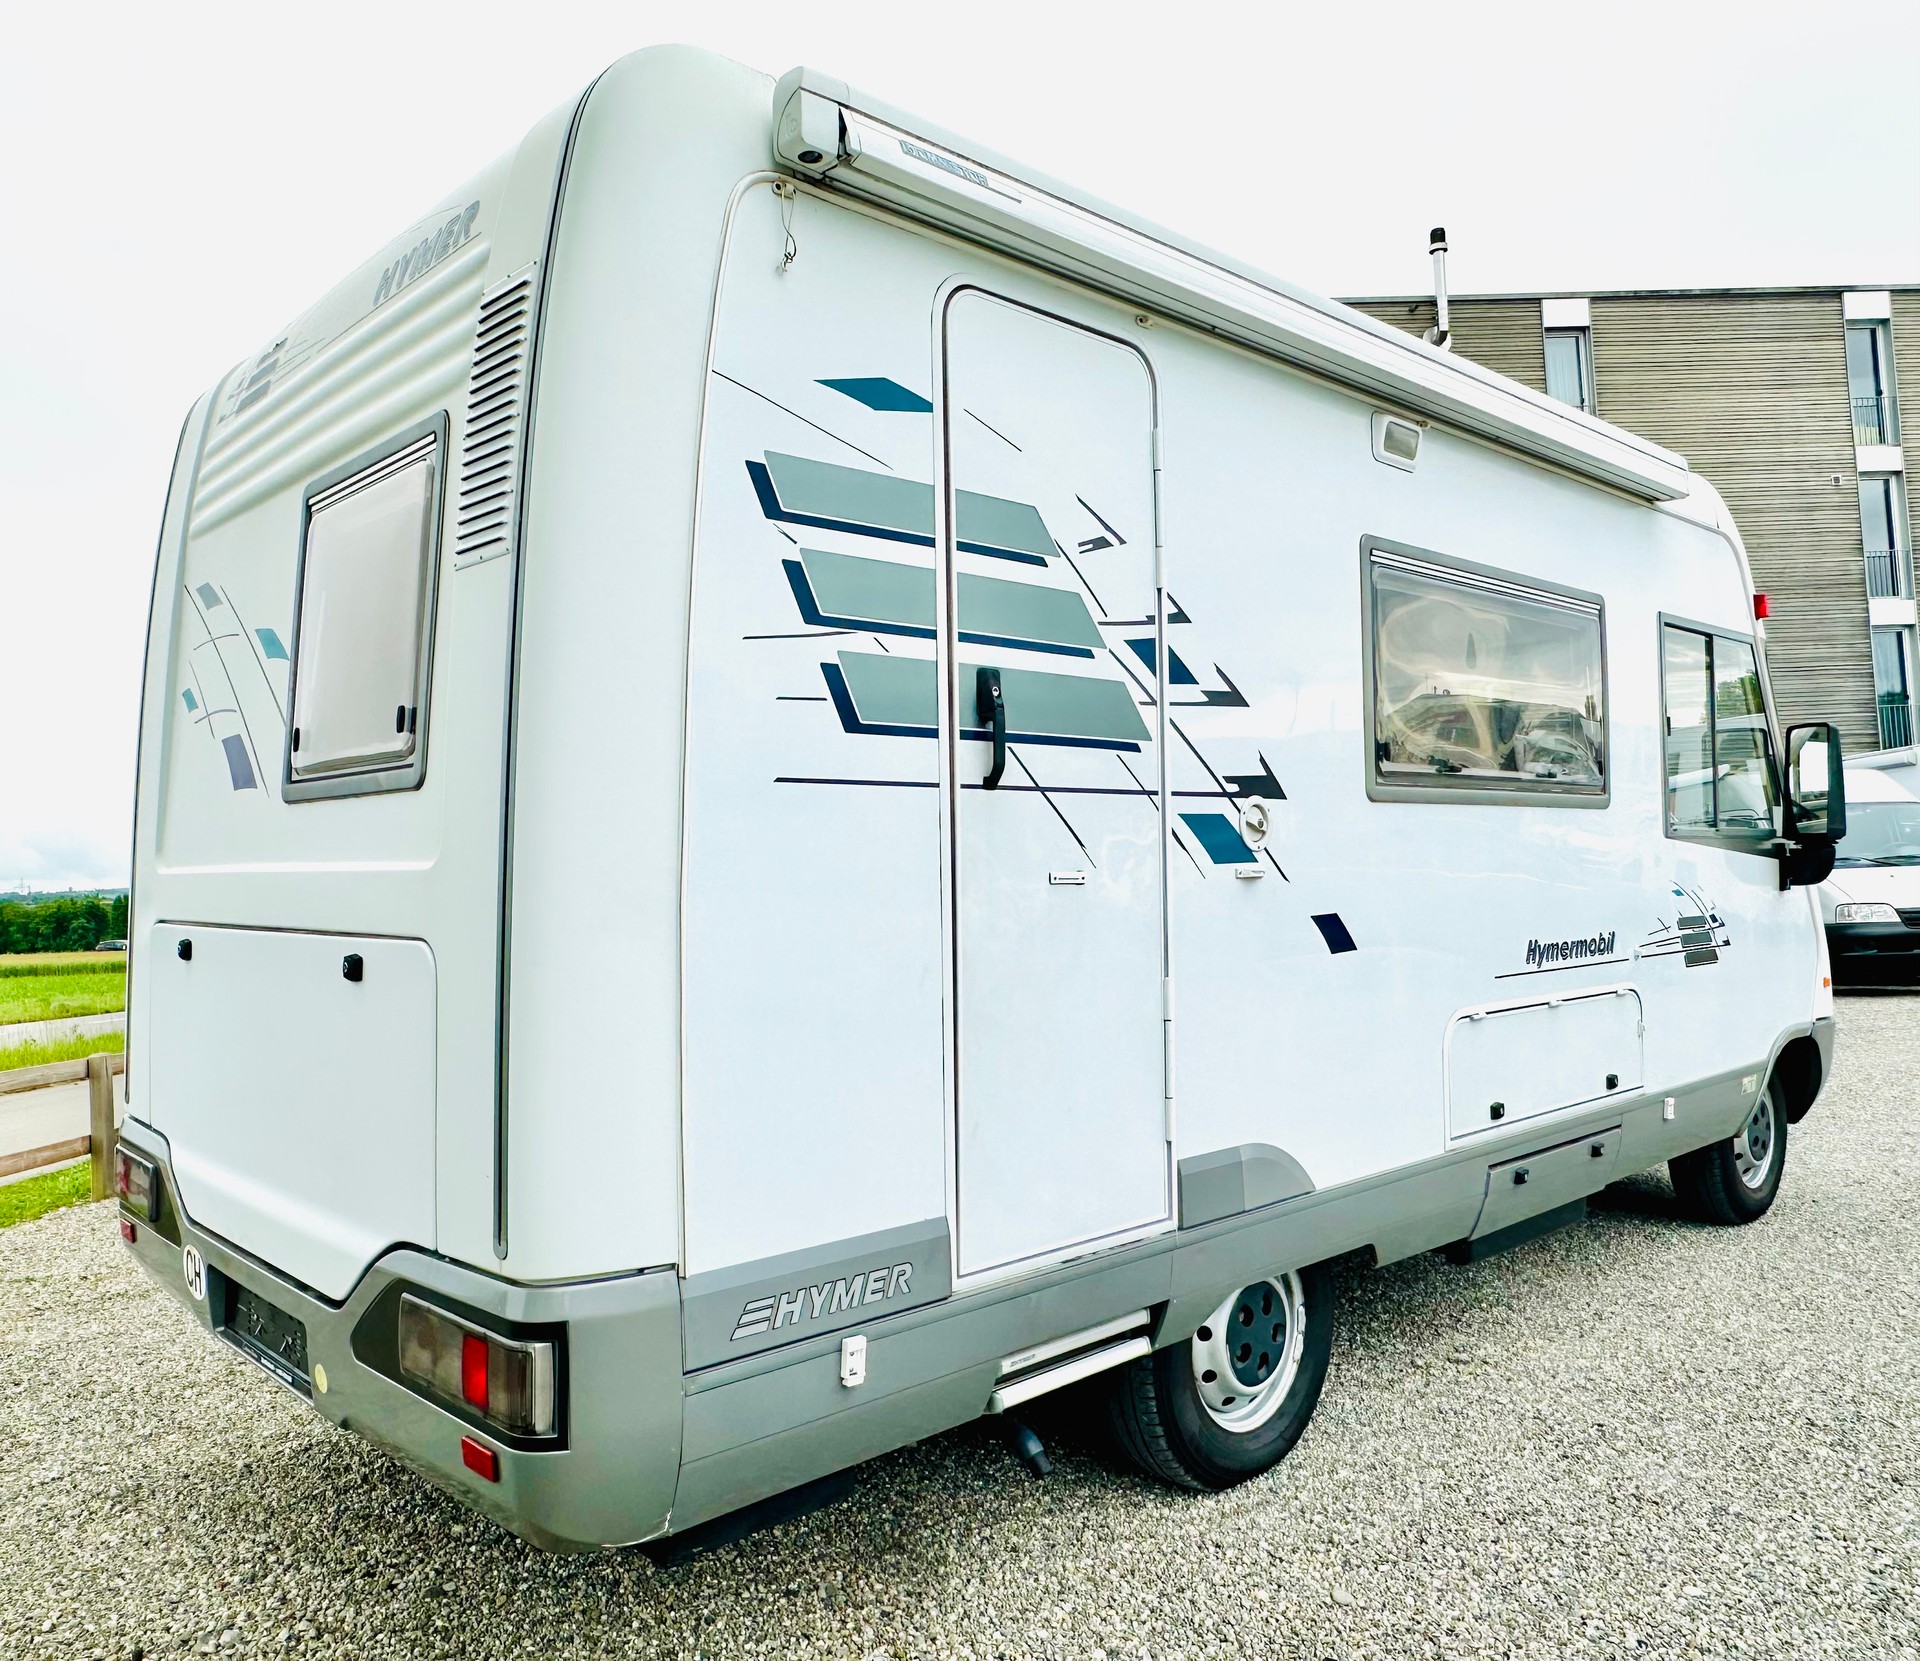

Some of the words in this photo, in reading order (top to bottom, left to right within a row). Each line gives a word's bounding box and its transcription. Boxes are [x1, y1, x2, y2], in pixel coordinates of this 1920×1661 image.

[373, 200, 480, 306] HYMER
[1526, 931, 1615, 968] Hymermobil
[186, 1250, 202, 1296] CH
[771, 1261, 914, 1331] HYMER
